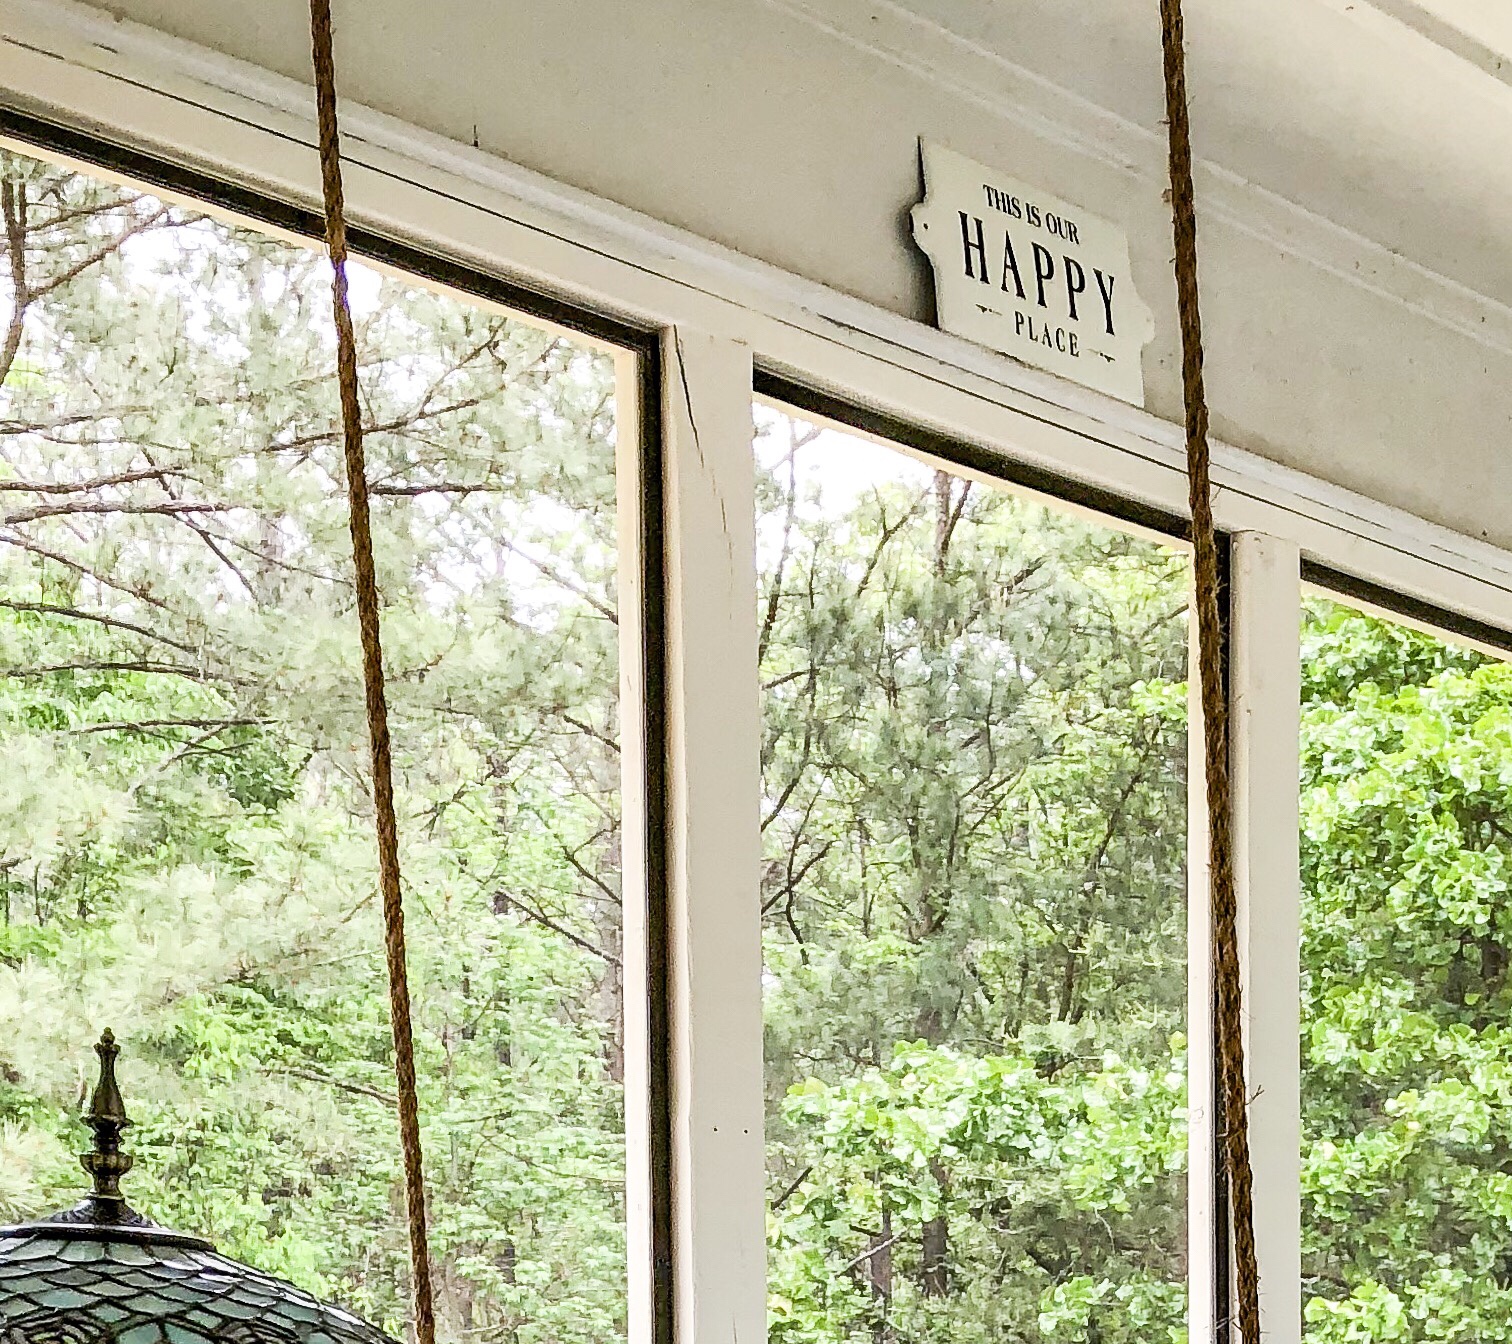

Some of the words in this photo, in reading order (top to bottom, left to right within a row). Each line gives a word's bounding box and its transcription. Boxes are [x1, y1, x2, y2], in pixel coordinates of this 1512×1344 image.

[983, 184, 1022, 219] THIS
[1025, 202, 1041, 228] IS
[1046, 212, 1080, 245] OUR
[958, 210, 1115, 336] HAPPY
[1014, 310, 1080, 357] PLACE
